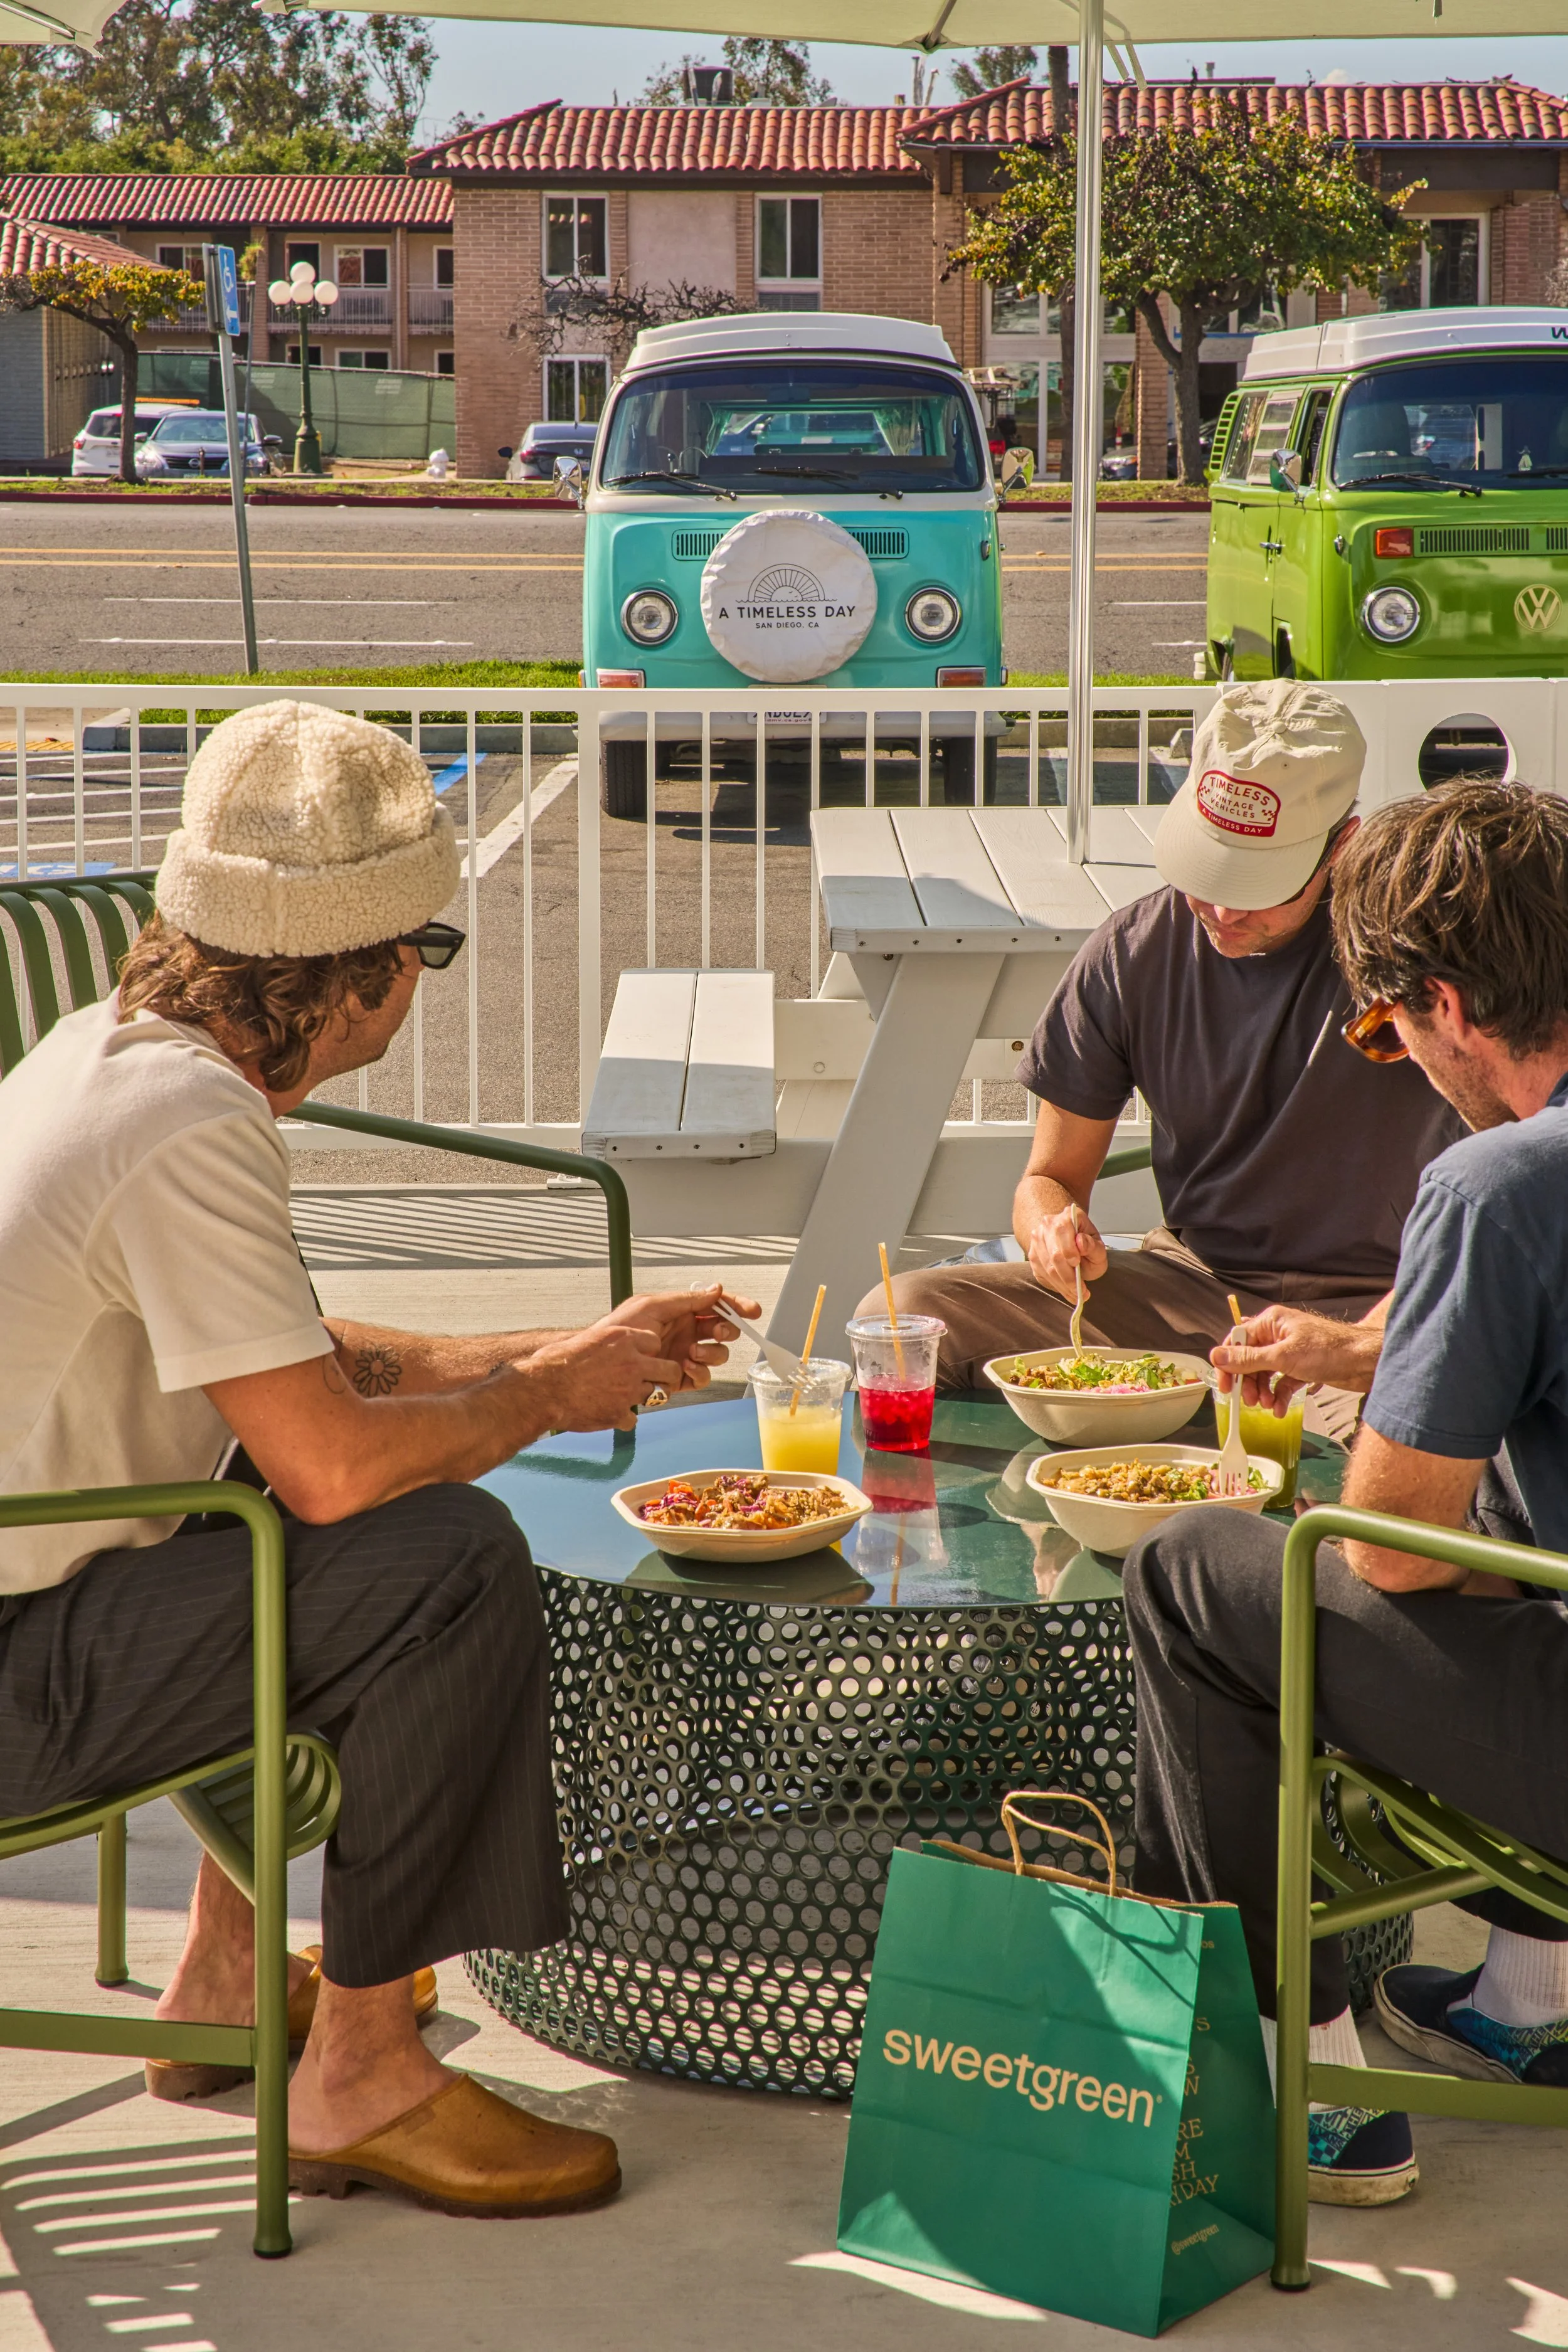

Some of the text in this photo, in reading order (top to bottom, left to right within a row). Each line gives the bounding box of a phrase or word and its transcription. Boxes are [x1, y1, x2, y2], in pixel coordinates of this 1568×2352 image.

[719, 606, 856, 618] A TIMELESS DAY
[1209, 776, 1270, 806] TIMELESS
[1215, 792, 1254, 811] VINTAGE
[1210, 797, 1255, 818] VEHICLES
[1208, 813, 1240, 830] TIMELESS
[882, 2029, 1155, 2127] sweetgreen
[1170, 2173, 1219, 2206] YDAY
[1171, 2223, 1220, 2255] @sweetgreen
